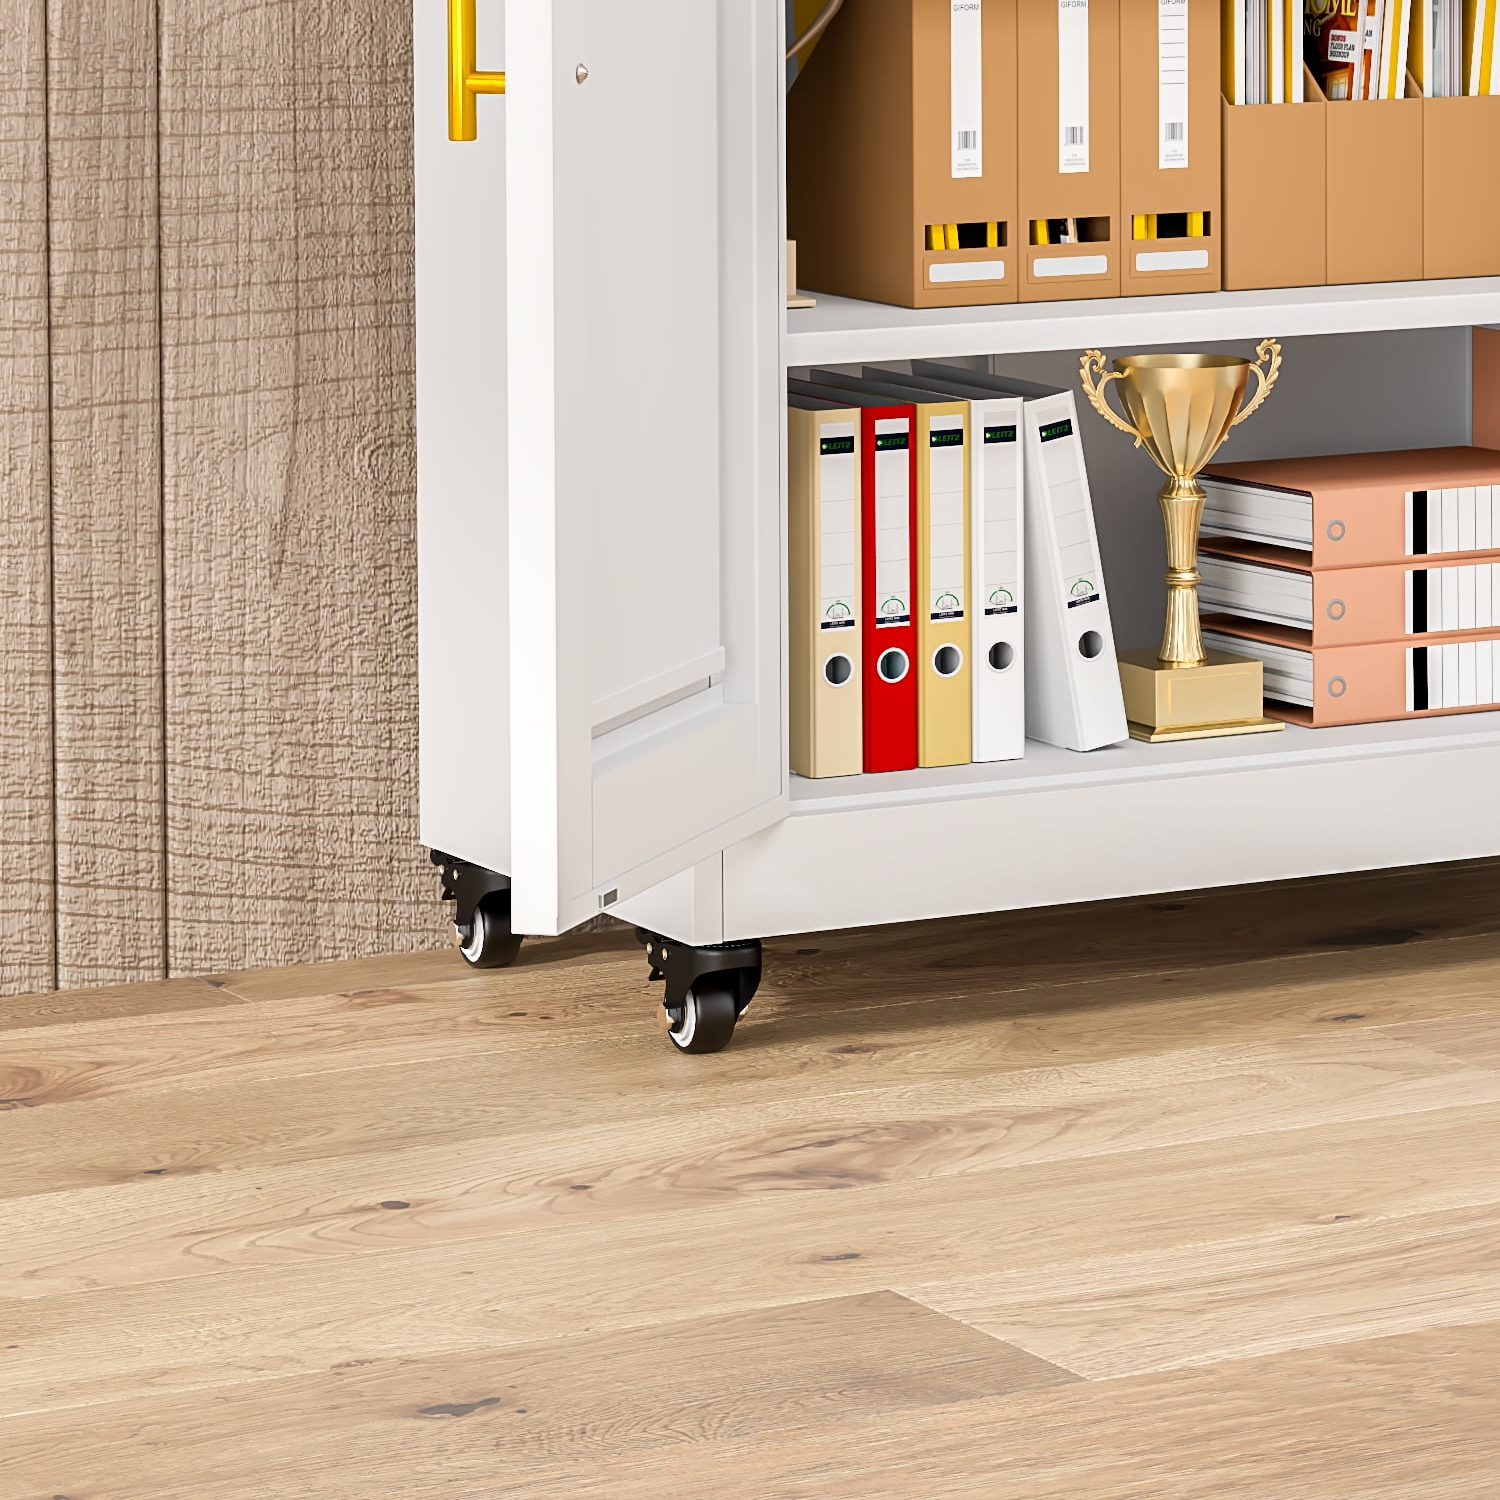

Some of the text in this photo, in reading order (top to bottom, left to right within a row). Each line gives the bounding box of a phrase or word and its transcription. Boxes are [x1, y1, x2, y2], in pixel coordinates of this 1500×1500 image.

[1060, 0, 1087, 9] GIFORM
[992, 430, 1015, 439] LEITZ
[1047, 424, 1070, 436] LEITZ
[884, 437, 906, 446] LEITZ
[939, 433, 961, 442] LEITZ
[829, 441, 851, 450] LEITZ
